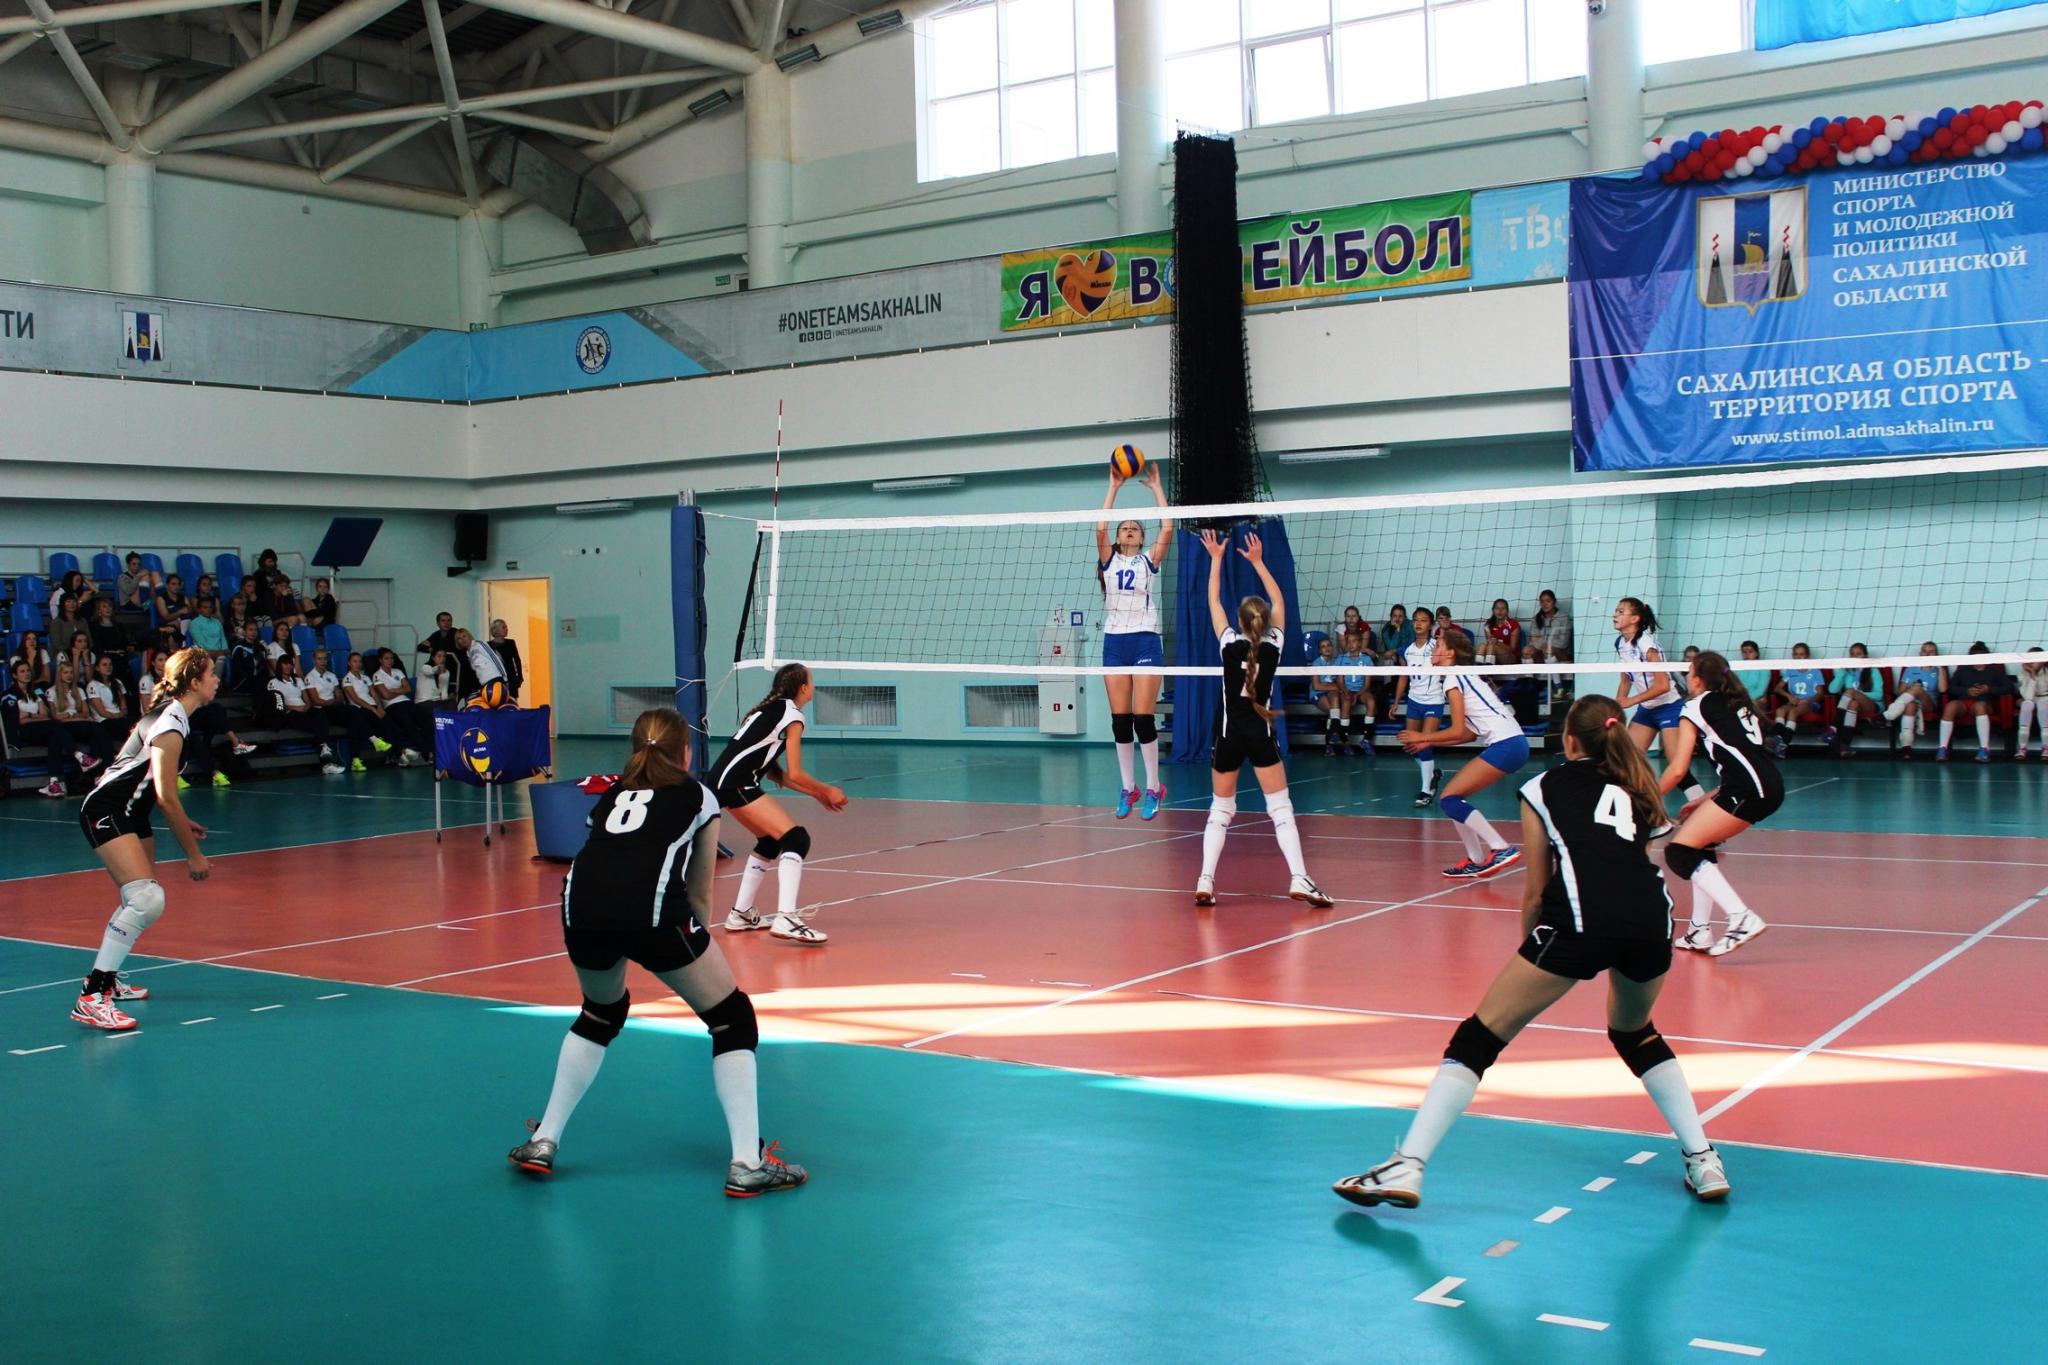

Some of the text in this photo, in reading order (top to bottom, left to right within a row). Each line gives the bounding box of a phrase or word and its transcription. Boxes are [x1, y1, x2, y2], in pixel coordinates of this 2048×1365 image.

[1833, 161, 2007, 195] МИНИСТЕРСТВО
[1833, 194, 1917, 216] СПОРТА
[1833, 201, 2016, 237] И МОЛОДЕЖНОЙ
[1832, 231, 1959, 258] ПОЛИТИКИ
[1832, 245, 2028, 283] САХАЛИНСКОЙ
[778, 292, 942, 332] #ONETEAMSAKHALIN
[1016, 271, 1050, 321] Я
[1833, 282, 1949, 307] ОБЛАСТИ
[1677, 361, 1885, 396] САХАЛИНСКАЯ
[1893, 350, 2032, 380] ОБЛАСТЬ
[1709, 380, 2018, 420] ТЕРРИТОРИЯ СПОРТА
[1731, 418, 1994, 446] www.stimol.admsakhalin.ru
[1115, 569, 1135, 591] 12
[1794, 681, 1808, 695] 12
[1736, 706, 1763, 745] 9
[605, 789, 654, 834] 8
[1593, 783, 1637, 842] 4
